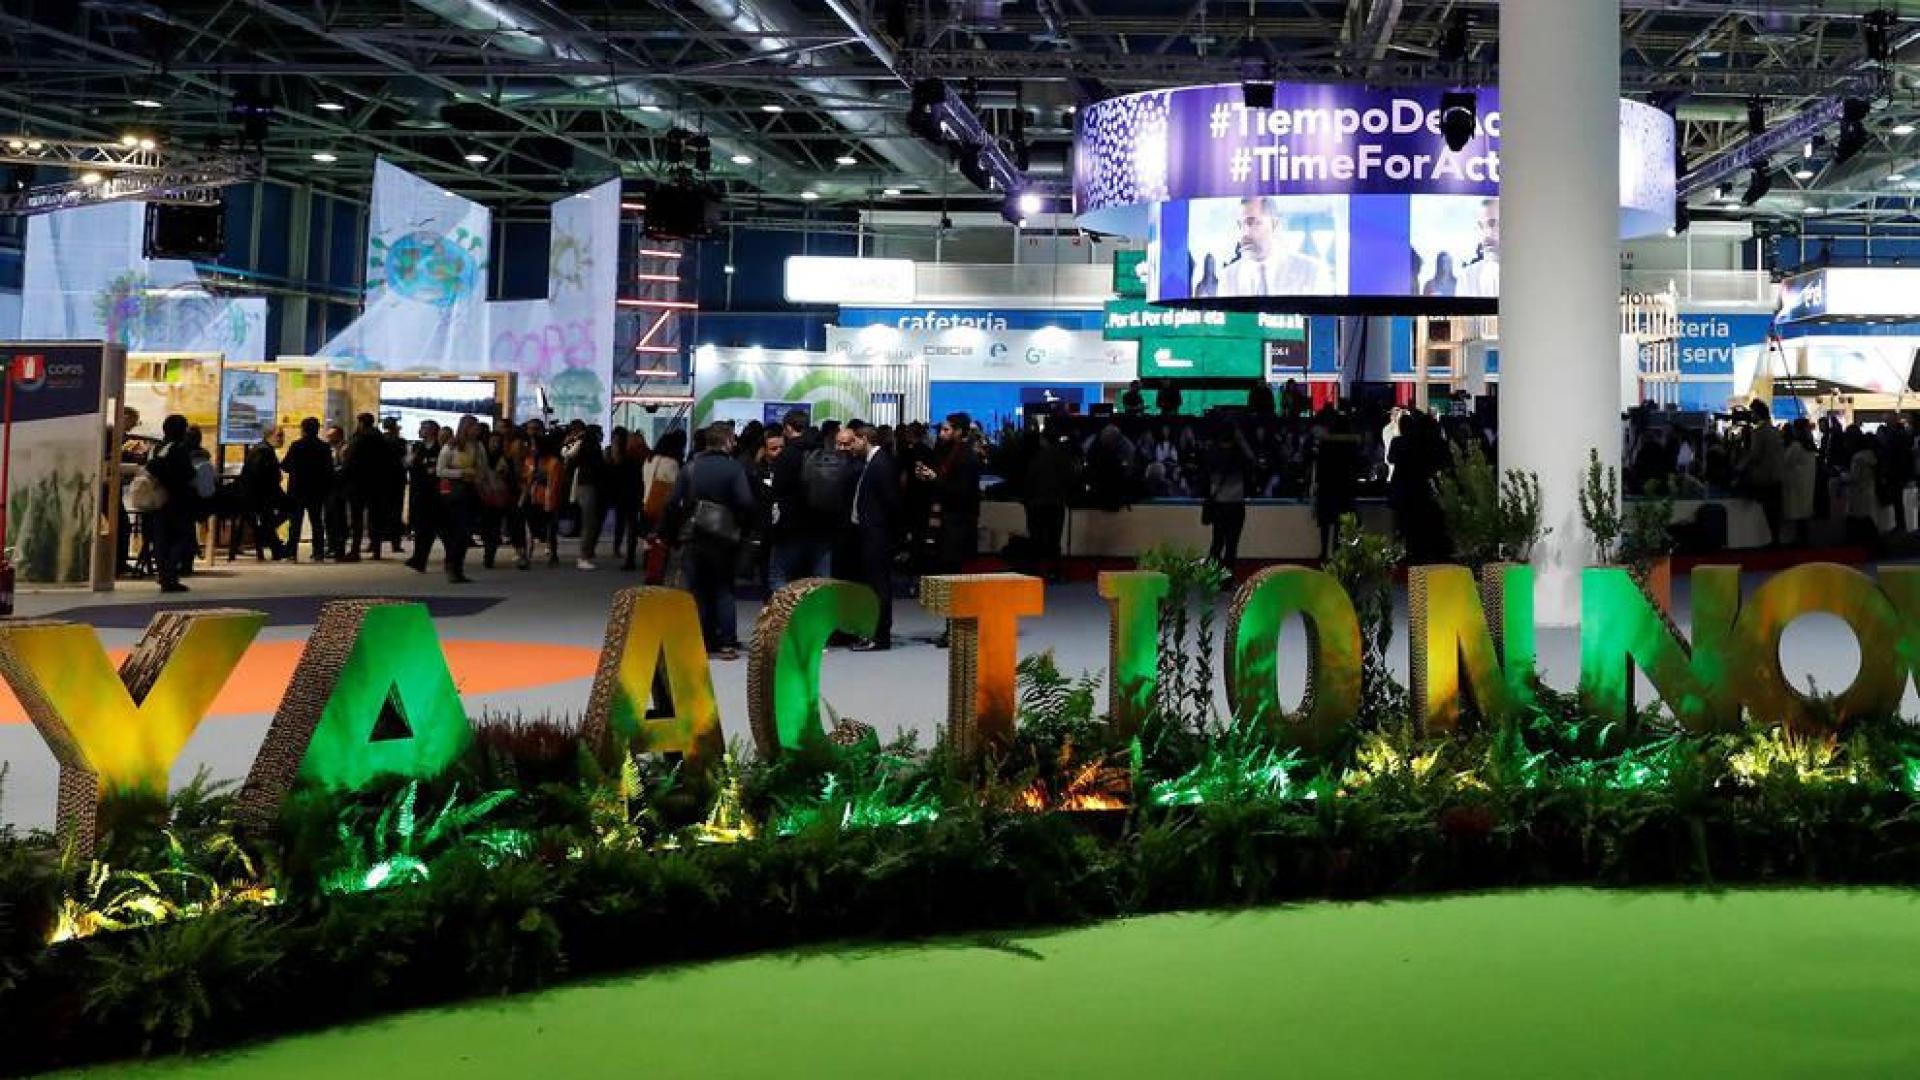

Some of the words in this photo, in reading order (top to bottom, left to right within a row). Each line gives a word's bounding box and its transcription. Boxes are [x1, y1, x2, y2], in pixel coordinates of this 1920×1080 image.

[0, 597, 474, 858] YA
[581, 563, 1535, 760] ACTION
[1580, 561, 1920, 738] NO
